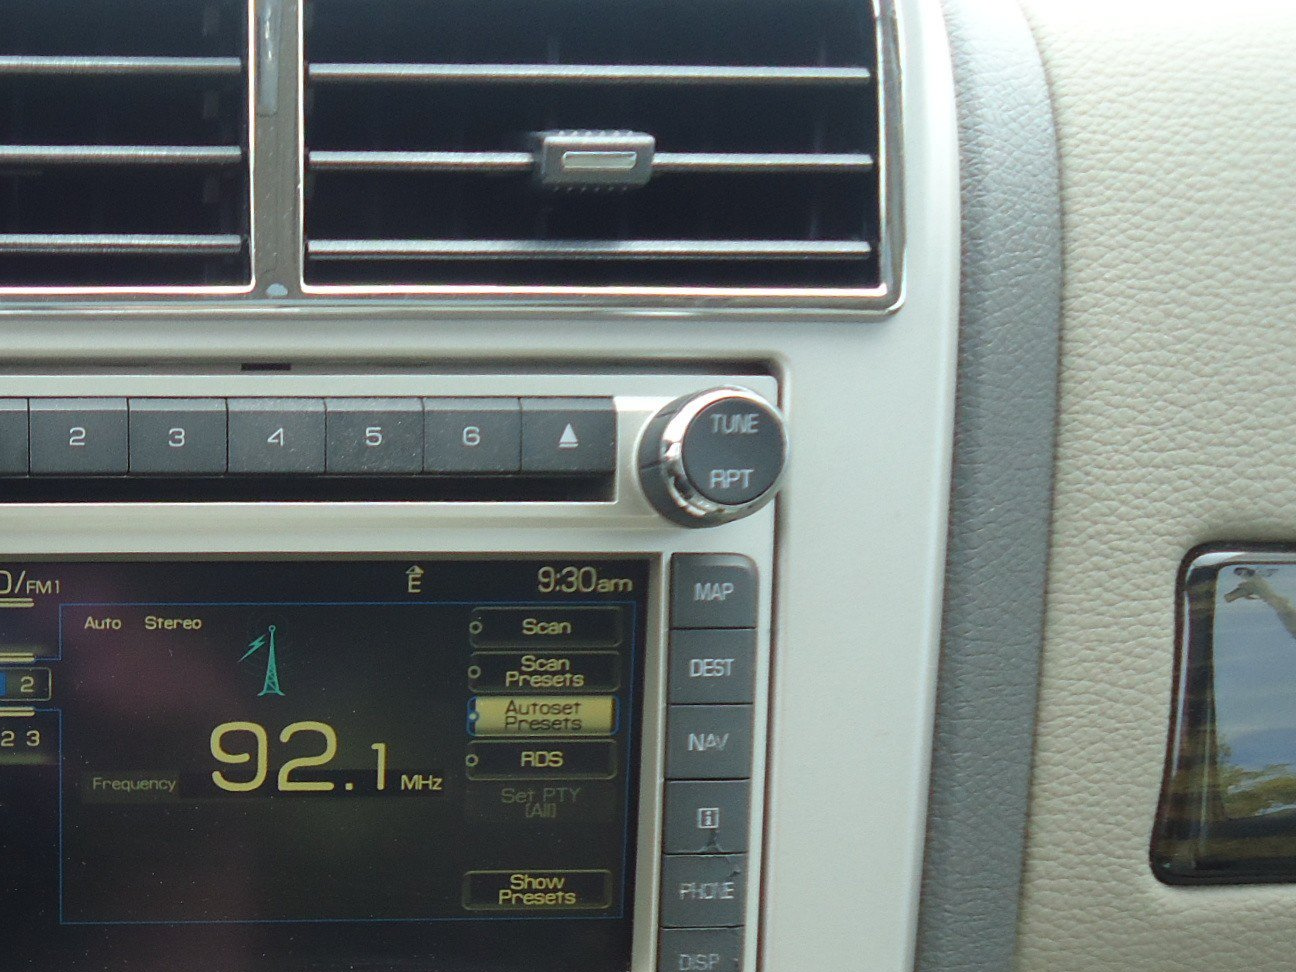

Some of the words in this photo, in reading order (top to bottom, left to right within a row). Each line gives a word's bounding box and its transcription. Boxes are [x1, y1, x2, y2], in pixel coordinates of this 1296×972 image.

[710, 413, 759, 434] TUNE
[69, 426, 86, 446] 2
[168, 427, 186, 447] 3
[267, 427, 284, 447] 4
[365, 426, 383, 446] 5
[462, 426, 481, 446] 6
[709, 468, 754, 489] RPT
[407, 573, 422, 594] E
[695, 582, 734, 601] MAP
[84, 616, 122, 630] Auto
[144, 615, 202, 630] Stereo
[522, 618, 572, 635] Scan
[520, 655, 571, 672] Scan
[690, 658, 735, 677] DEST
[20, 675, 35, 693] 2
[505, 671, 584, 689] Presets
[505, 700, 582, 717] Autoset
[505, 716, 583, 732] Presets
[0, 730, 15, 747] 2
[26, 729, 40, 747] 3
[688, 733, 729, 751] NAV
[209, 719, 387, 793] 92.1
[400, 773, 443, 792] MHz
[521, 750, 563, 767] RDS
[92, 775, 177, 793] Frequency
[510, 873, 565, 890] Show
[498, 889, 576, 906] Presets
